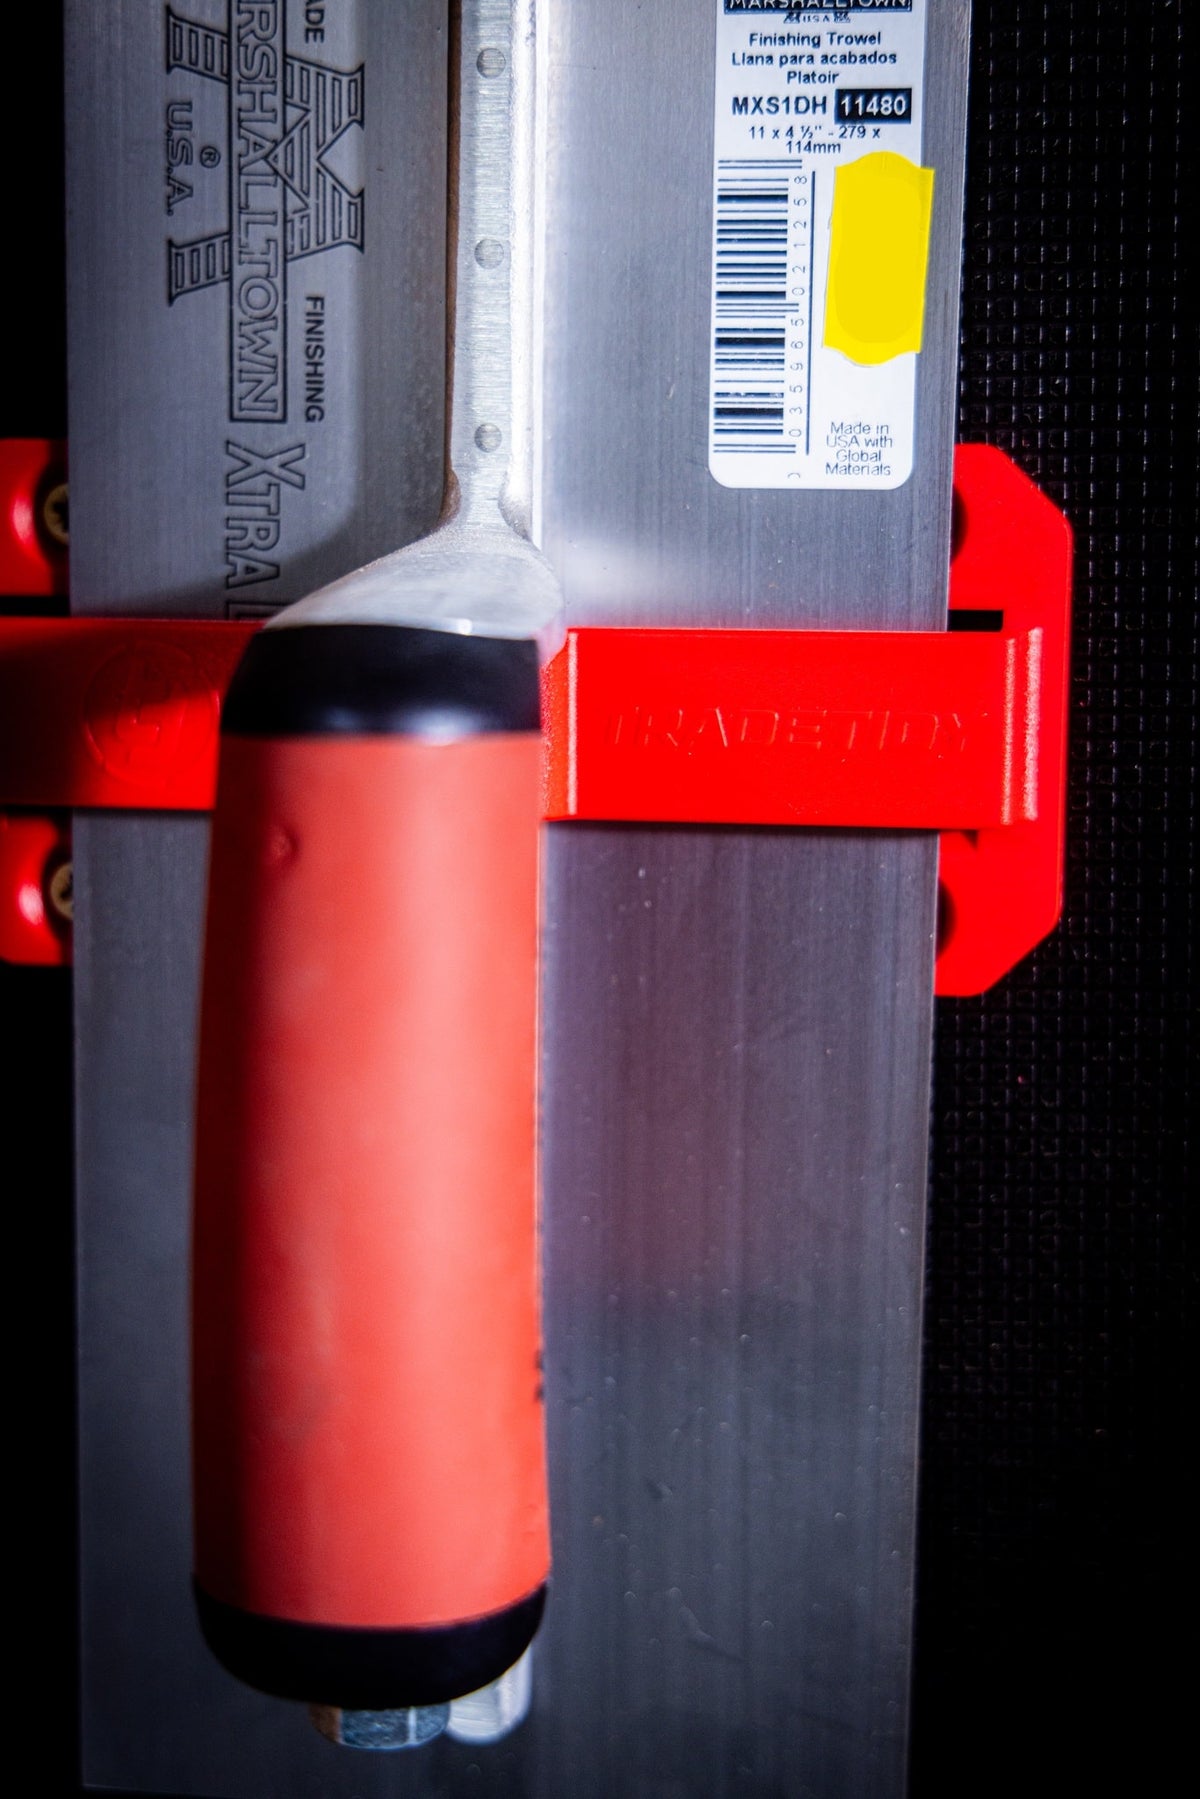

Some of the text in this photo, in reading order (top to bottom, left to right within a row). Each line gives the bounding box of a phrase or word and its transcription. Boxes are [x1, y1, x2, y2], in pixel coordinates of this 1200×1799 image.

[749, 32, 881, 49] Finishing Trowel
[732, 51, 897, 68] Llana para acabados
[787, 71, 839, 85] Platoir
[732, 95, 907, 117] MXS1DH 11480
[749, 126, 765, 139] 11
[838, 126, 866, 139] 279
[785, 141, 841, 154] 114mm
[305, 296, 325, 423] FINISHING
[830, 421, 890, 435] Made in
[826, 435, 893, 448] USA with
[836, 449, 882, 463] Global
[825, 462, 892, 476] Materials
